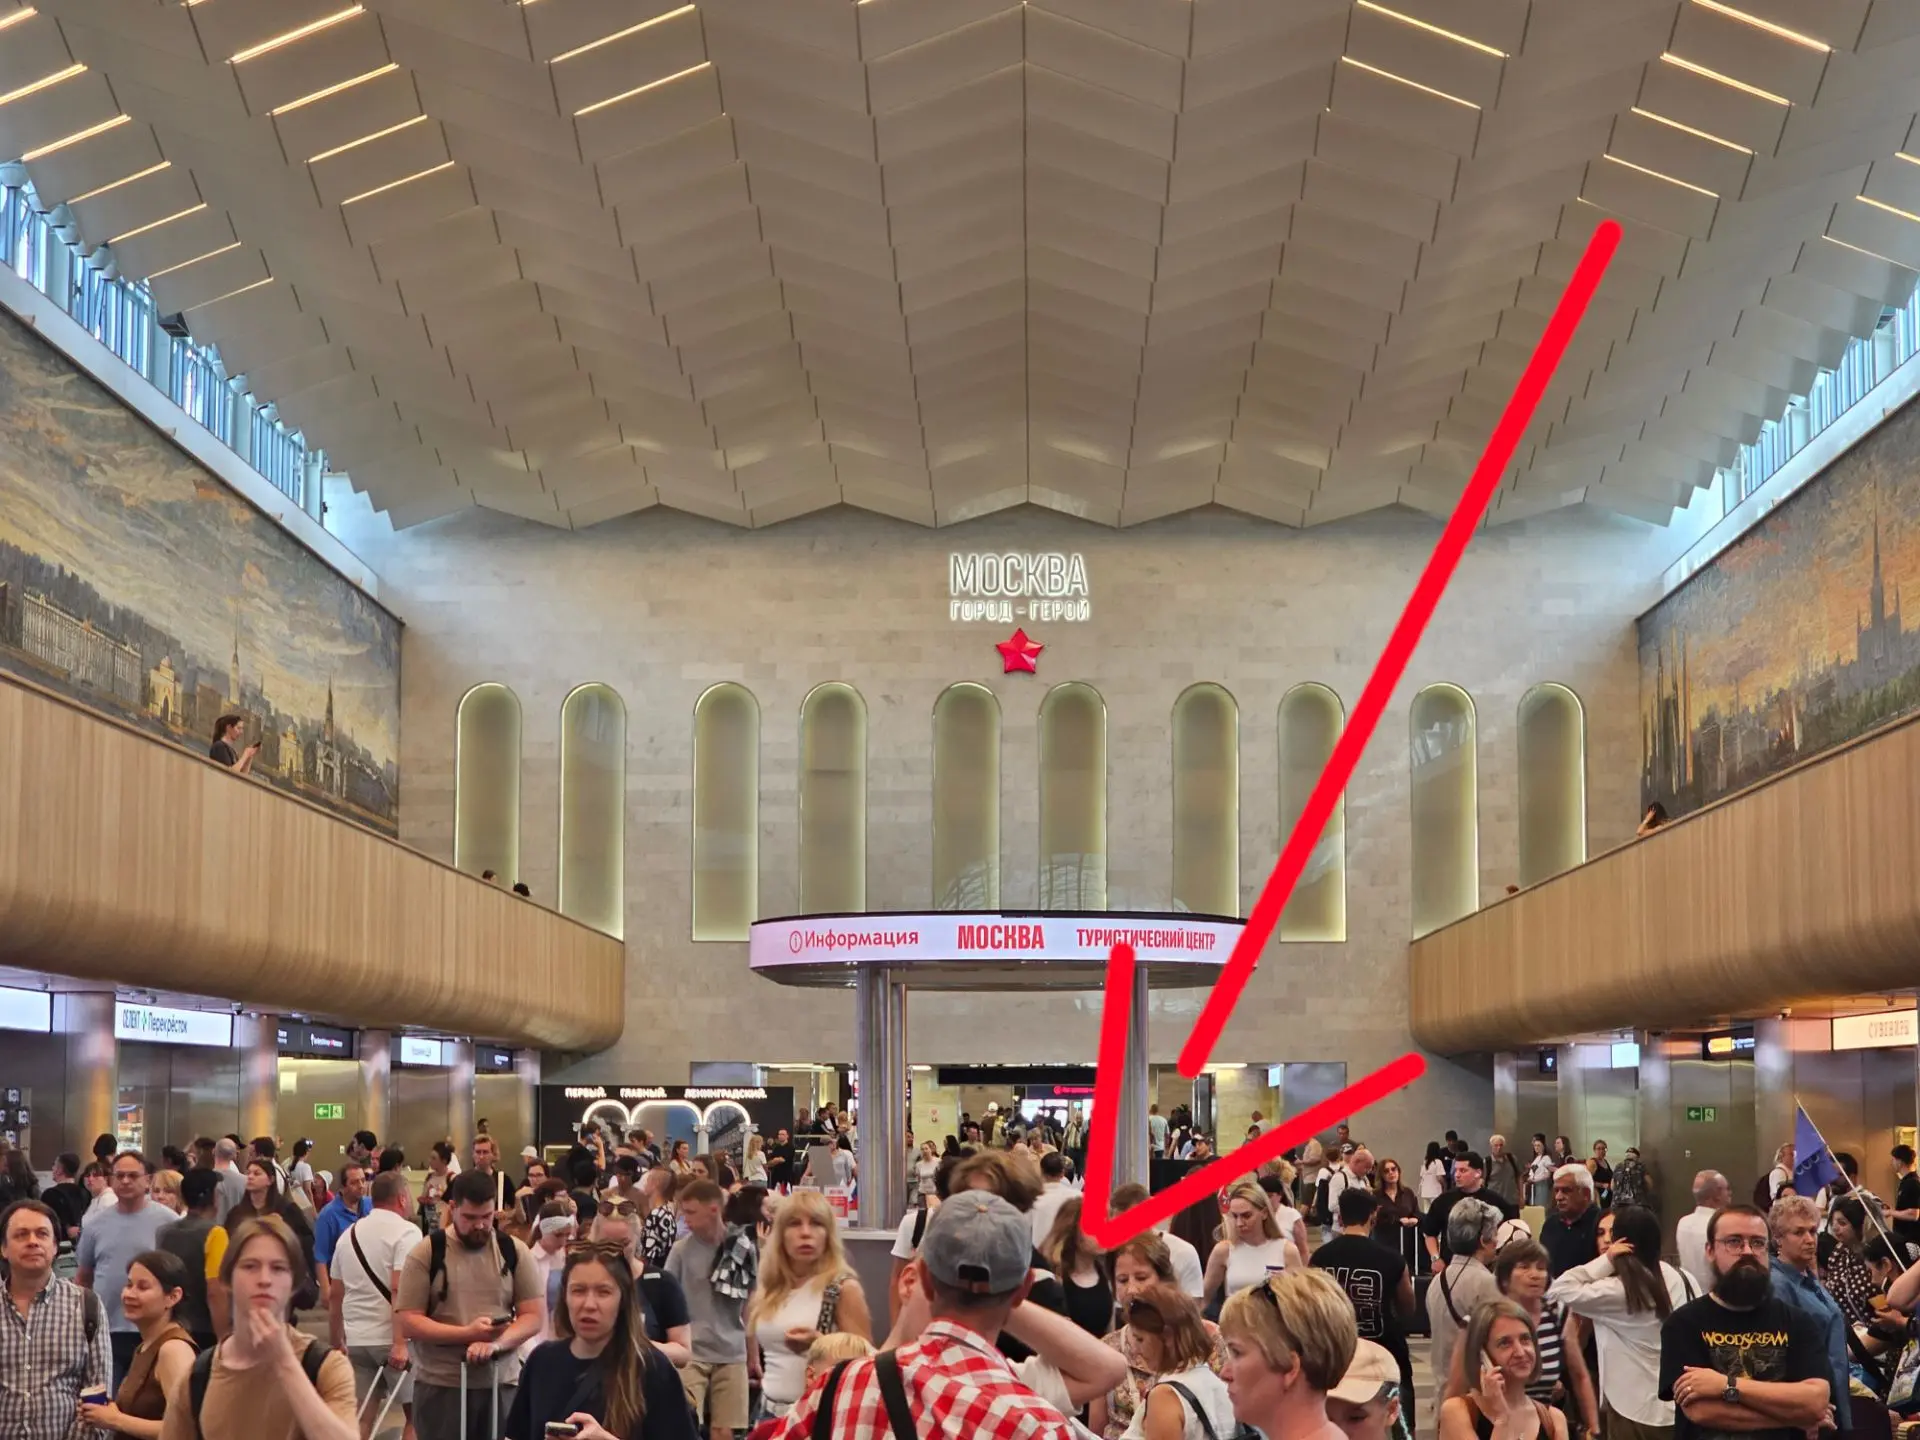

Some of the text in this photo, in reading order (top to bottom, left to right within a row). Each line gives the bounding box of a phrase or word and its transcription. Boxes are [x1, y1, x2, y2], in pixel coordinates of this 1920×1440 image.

[950, 552, 1088, 596] МОСКВА
[804, 929, 918, 950] Информация
[958, 924, 1044, 949] МОСКВА
[1077, 928, 1216, 951] ТУРИСТИЧЕСКИЙ ЦЕНТР
[1702, 1331, 1788, 1349] WOODSCREAM
